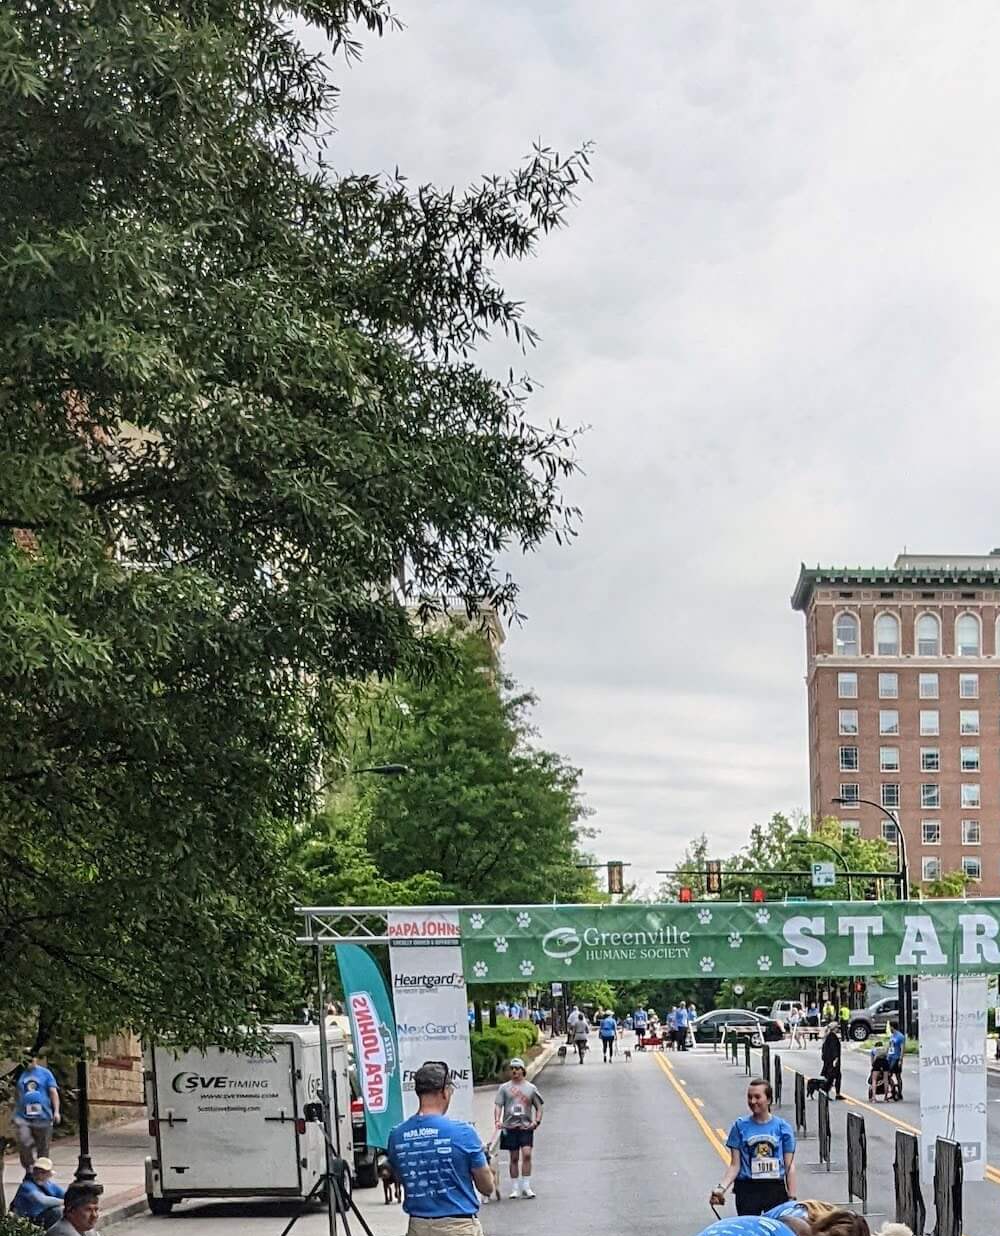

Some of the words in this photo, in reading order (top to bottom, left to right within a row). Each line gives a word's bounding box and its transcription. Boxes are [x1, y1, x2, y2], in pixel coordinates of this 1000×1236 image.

[389, 922, 420, 936] PAPA
[421, 921, 463, 936] JOHNS
[583, 926, 690, 947] Greenville
[586, 949, 637, 961] HUMANE
[640, 947, 690, 960] SOCIETY
[394, 972, 455, 988] Heartgard
[397, 1022, 457, 1034] NexGard
[185, 1076, 229, 1089] SVE
[228, 1080, 269, 1089] TIMING
